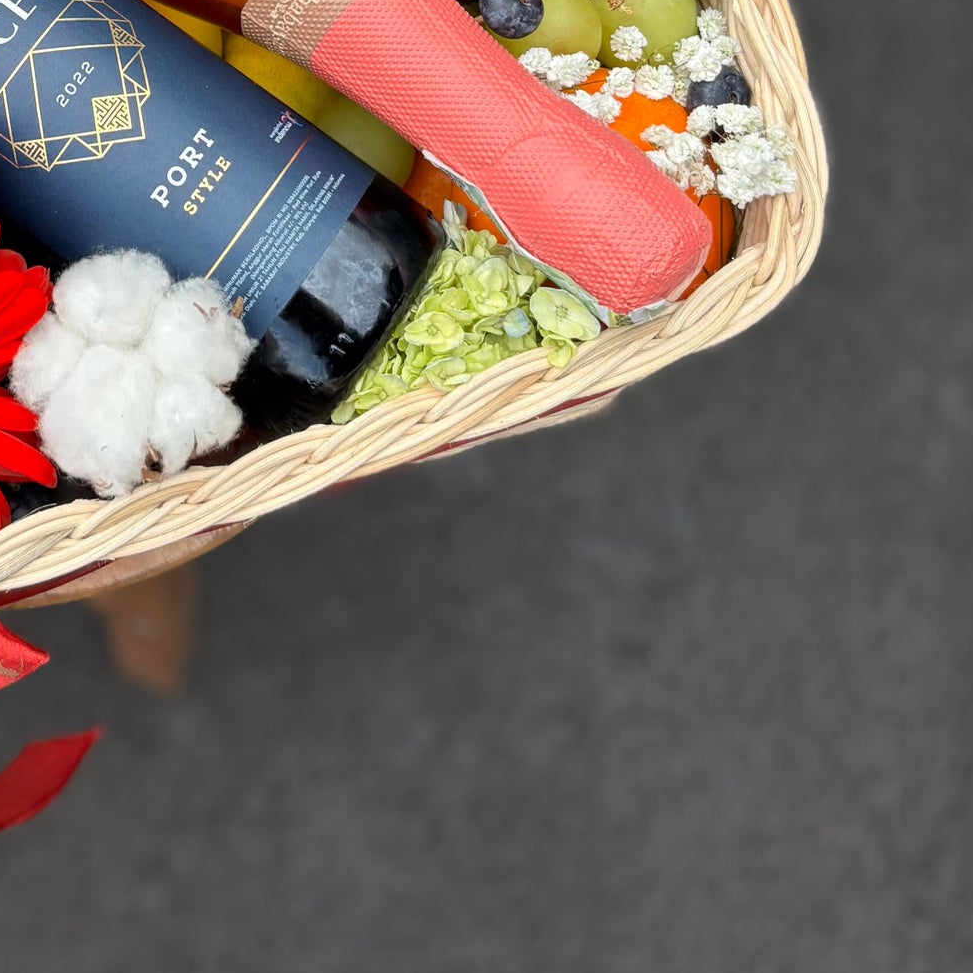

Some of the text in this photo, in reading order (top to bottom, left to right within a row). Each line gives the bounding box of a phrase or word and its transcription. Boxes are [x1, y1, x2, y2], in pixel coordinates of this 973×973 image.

[54, 58, 95, 109] 2022
[149, 127, 215, 209] PORT
[183, 155, 232, 217] STYLE
[264, 216, 279, 234] BPOM
[245, 280, 260, 297] UMUR
[261, 256, 277, 275] TAHUN
[273, 243, 286, 258] ATAU
[282, 224, 300, 245] WANITA
[247, 251, 264, 271] Anggur
[260, 235, 274, 252] Merah
[259, 266, 279, 290] SABABAY
